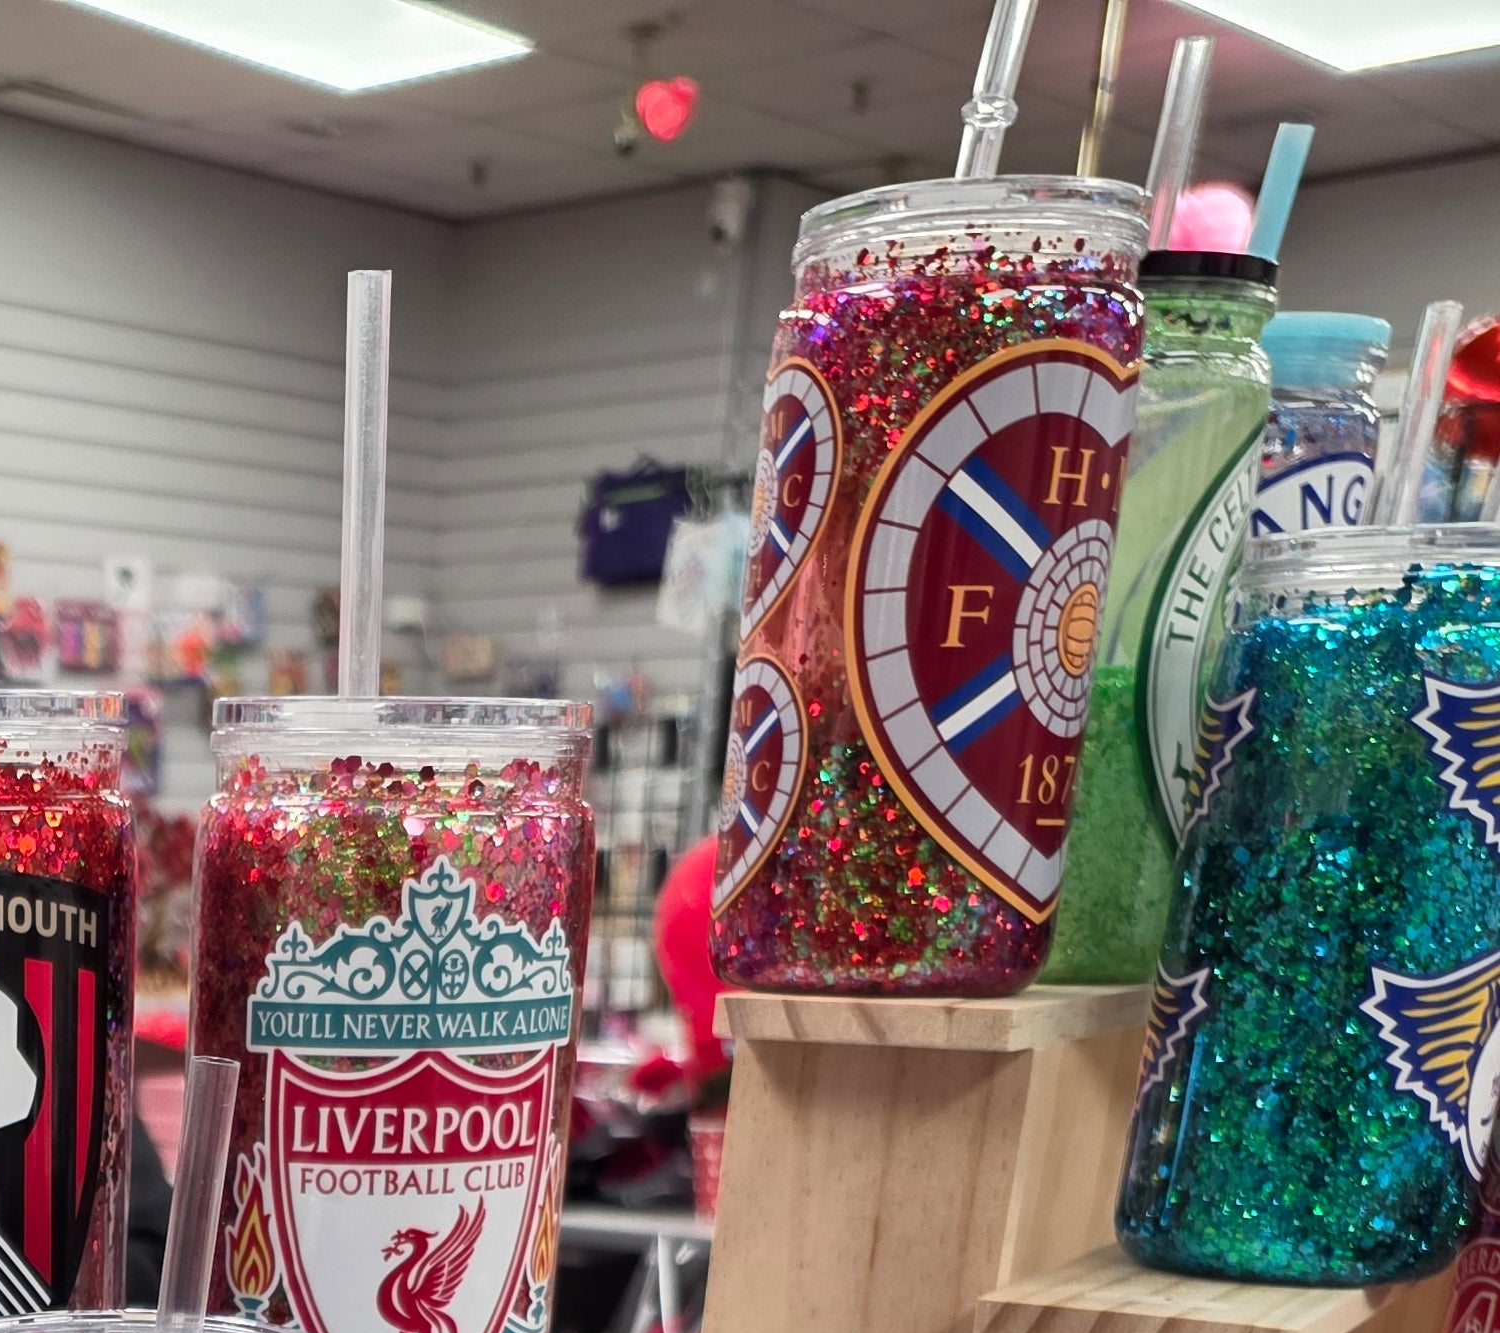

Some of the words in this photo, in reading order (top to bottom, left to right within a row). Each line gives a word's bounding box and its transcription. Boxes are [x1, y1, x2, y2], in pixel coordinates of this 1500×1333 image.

[940, 584, 995, 648] F
[1165, 554, 1215, 650] THE
[257, 1010, 338, 1041] YOU'LL
[342, 1013, 432, 1040] NEVER
[436, 1011, 508, 1039] WALK
[512, 1004, 568, 1035] ALONE
[292, 1101, 536, 1155] LIVERPOOL
[300, 1167, 456, 1197] FOOTBALL
[463, 1164, 526, 1194] CLUB
